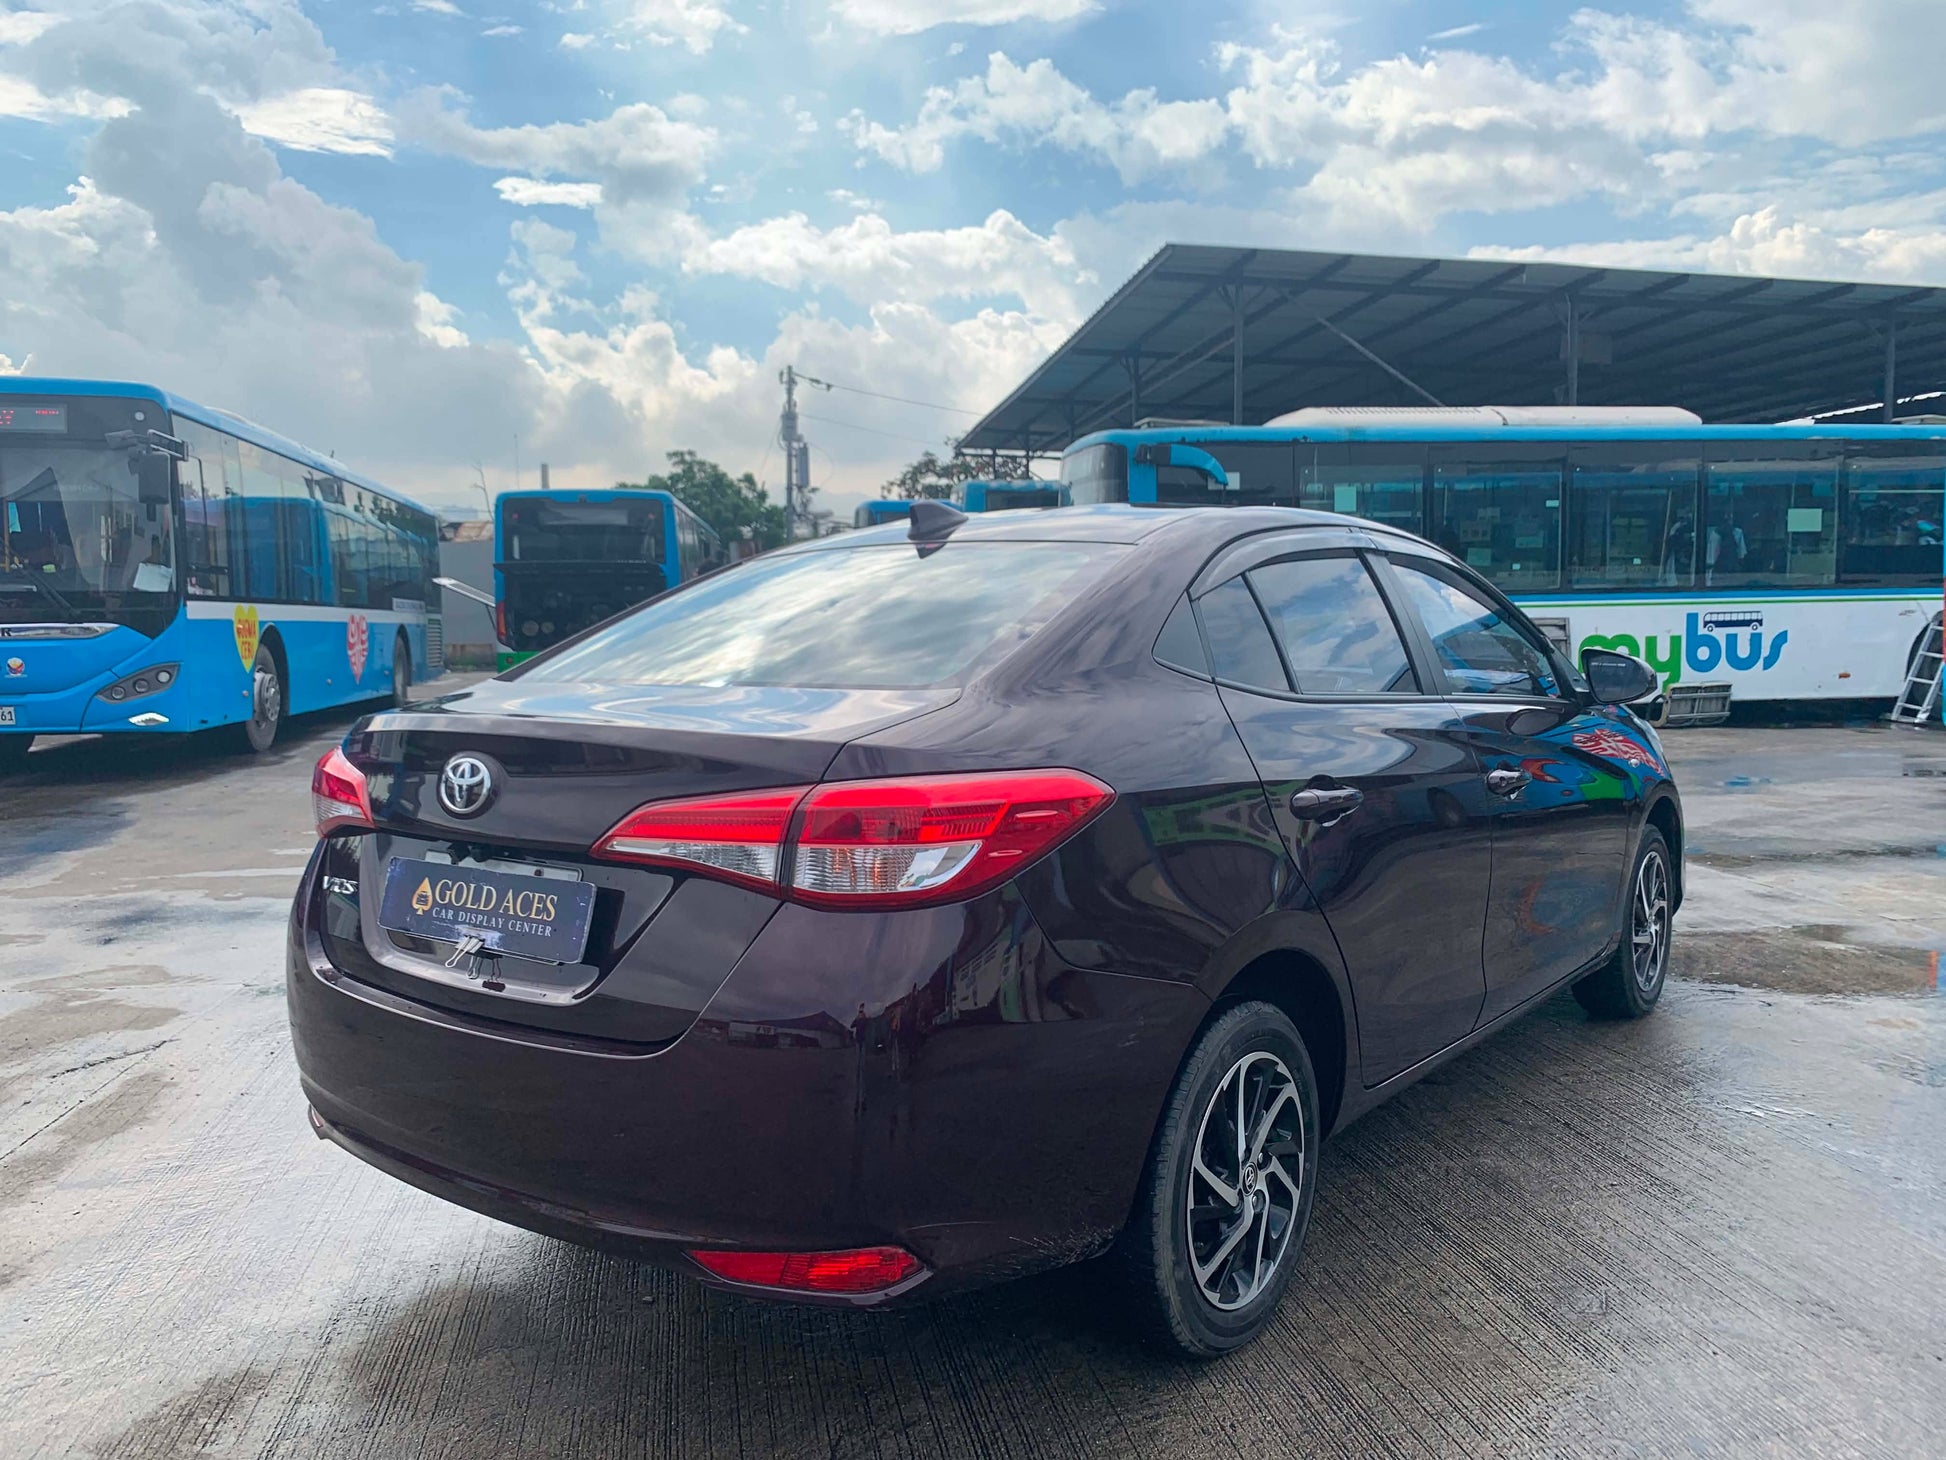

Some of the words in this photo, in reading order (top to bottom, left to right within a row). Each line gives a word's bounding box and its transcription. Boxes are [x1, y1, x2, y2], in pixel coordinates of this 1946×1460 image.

[435, 879, 497, 911] GOLD
[499, 888, 558, 921] ACES
[432, 907, 454, 920] CAR
[458, 911, 505, 928] DISPLAY
[508, 919, 552, 937] CENTER
